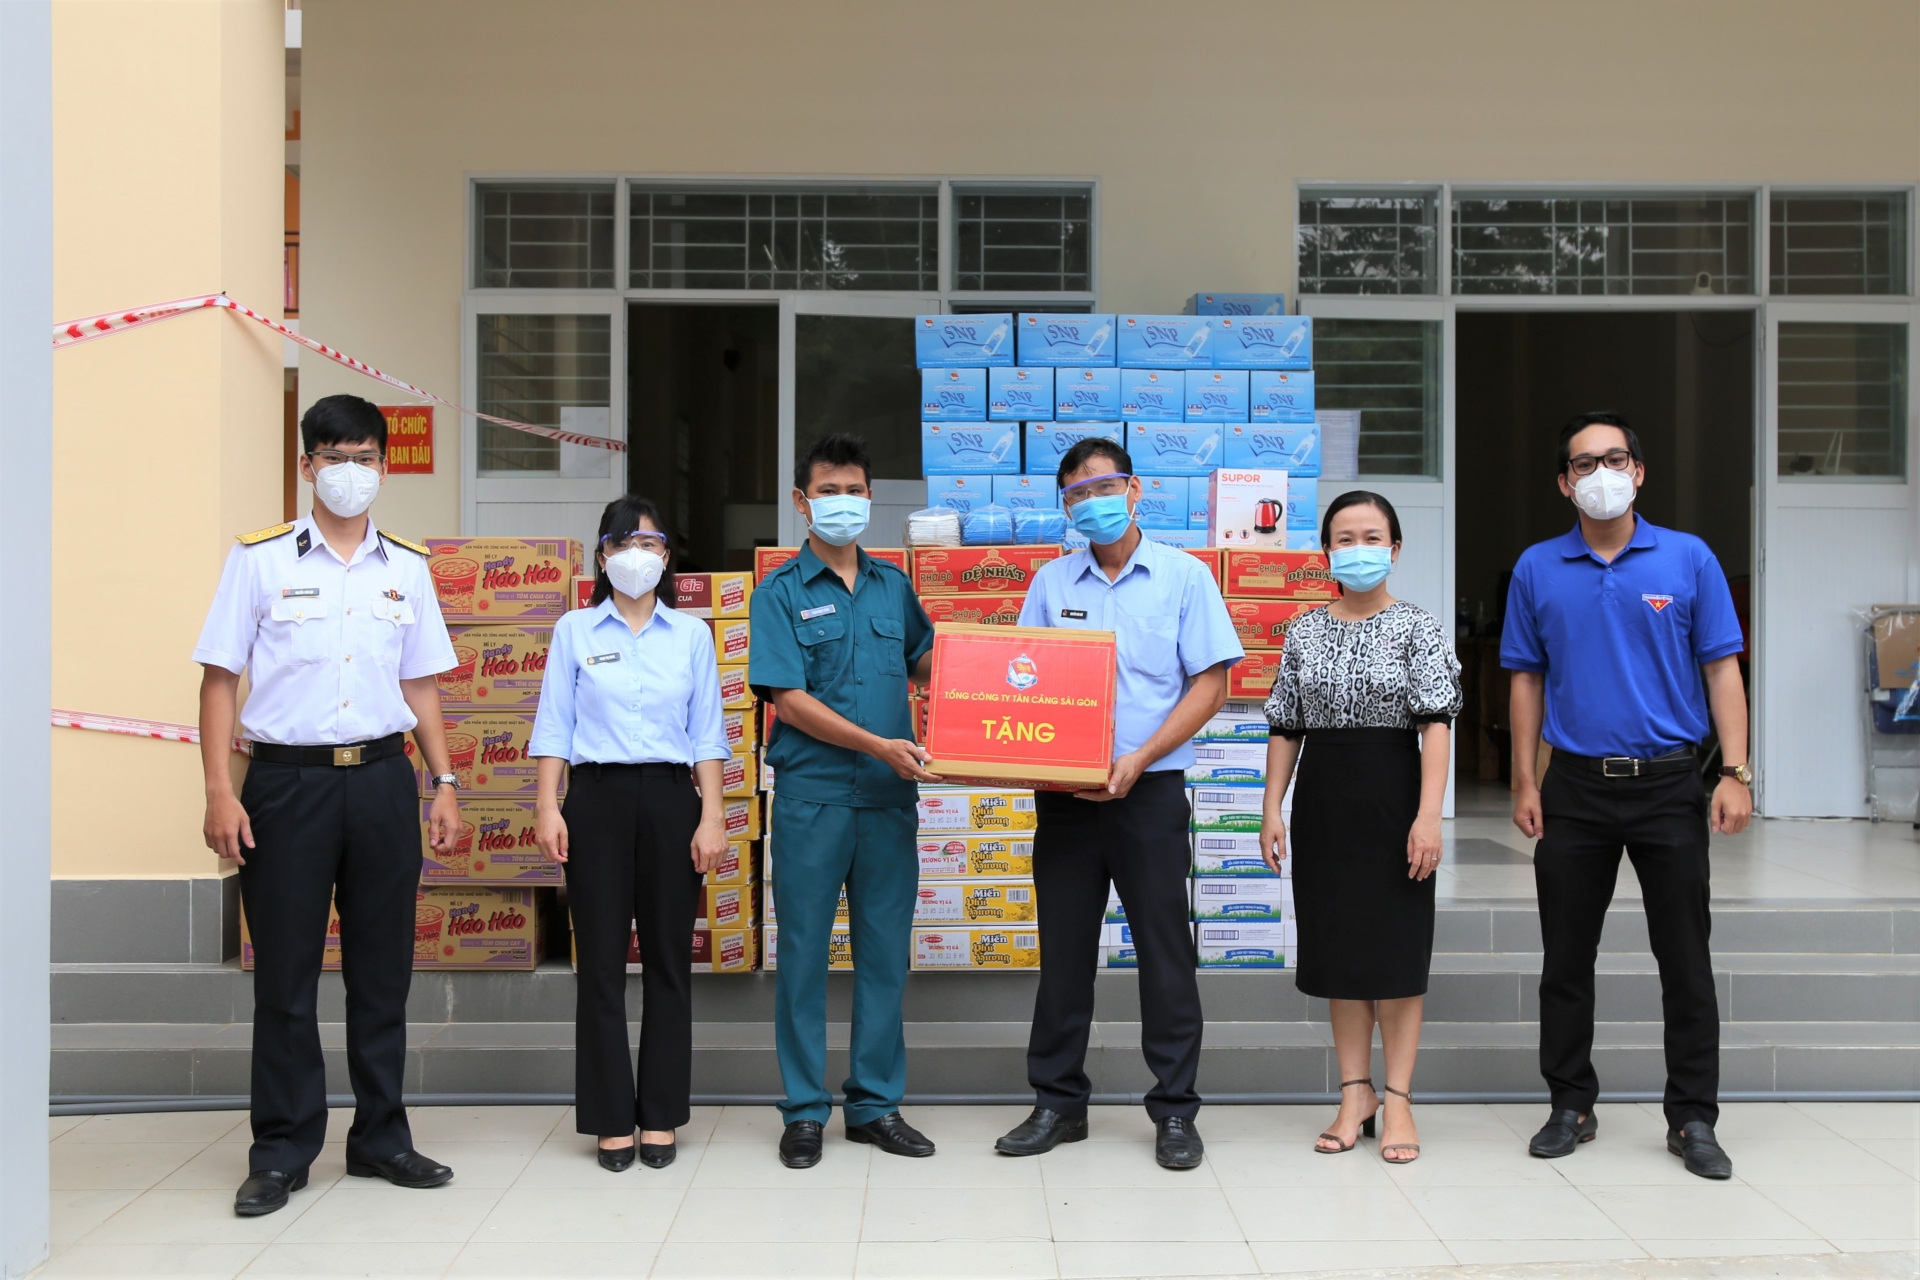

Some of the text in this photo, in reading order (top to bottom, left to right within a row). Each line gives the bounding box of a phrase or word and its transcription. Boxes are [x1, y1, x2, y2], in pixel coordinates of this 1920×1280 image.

[944, 325, 976, 340] SNP
[1048, 325, 1079, 340] SNP
[1146, 326, 1178, 342] SNP
[1243, 326, 1274, 342] SNP
[940, 391, 965, 403] SNP
[1008, 390, 1032, 402] SNP
[1074, 390, 1099, 403] SNP
[1138, 392, 1163, 405] SNP
[1203, 393, 1228, 405] SNP
[1270, 393, 1294, 406] SNP
[386, 409, 427, 434] TỔ CHỨC
[951, 432, 983, 447] SNP
[1156, 433, 1188, 450] SNP
[1253, 434, 1285, 450] SNP
[390, 440, 430, 464] BAN ĐẦU
[1222, 474, 1260, 482] SUPOR
[1142, 499, 1166, 512] SNP
[484, 556, 514, 571] Handy
[1260, 562, 1288, 572] PHỞ BÒ
[483, 560, 562, 590] Hảo Hảo
[920, 570, 952, 582] PHỞ BÒ
[962, 564, 1026, 583] ĐỆ NHẤT
[1288, 568, 1304, 582] ĐỆ
[680, 578, 704, 592] Gia
[952, 608, 982, 618] PHỞ BÒ
[1251, 623, 1262, 634] BÒ
[483, 644, 513, 658] Handy
[481, 648, 548, 677] Hảo Hả
[945, 688, 969, 700] TỔNG
[972, 692, 999, 701] CÔNG
[1013, 694, 1029, 703] TÂN
[1032, 694, 1058, 705] CẢNG
[1060, 696, 1074, 705] SÀI
[1077, 697, 1097, 707] GÒN
[982, 716, 1055, 745] TẶNG
[482, 731, 513, 746] Handy
[481, 741, 519, 765] Hảo
[980, 797, 1007, 806] Miến
[480, 818, 510, 834] Handy
[479, 828, 516, 852] Hảo
[980, 842, 1006, 851] Miến
[974, 888, 1000, 898] Miến
[449, 903, 479, 918] Handy
[448, 907, 526, 936] Hảo Hảo
[981, 934, 1007, 943] Miến
